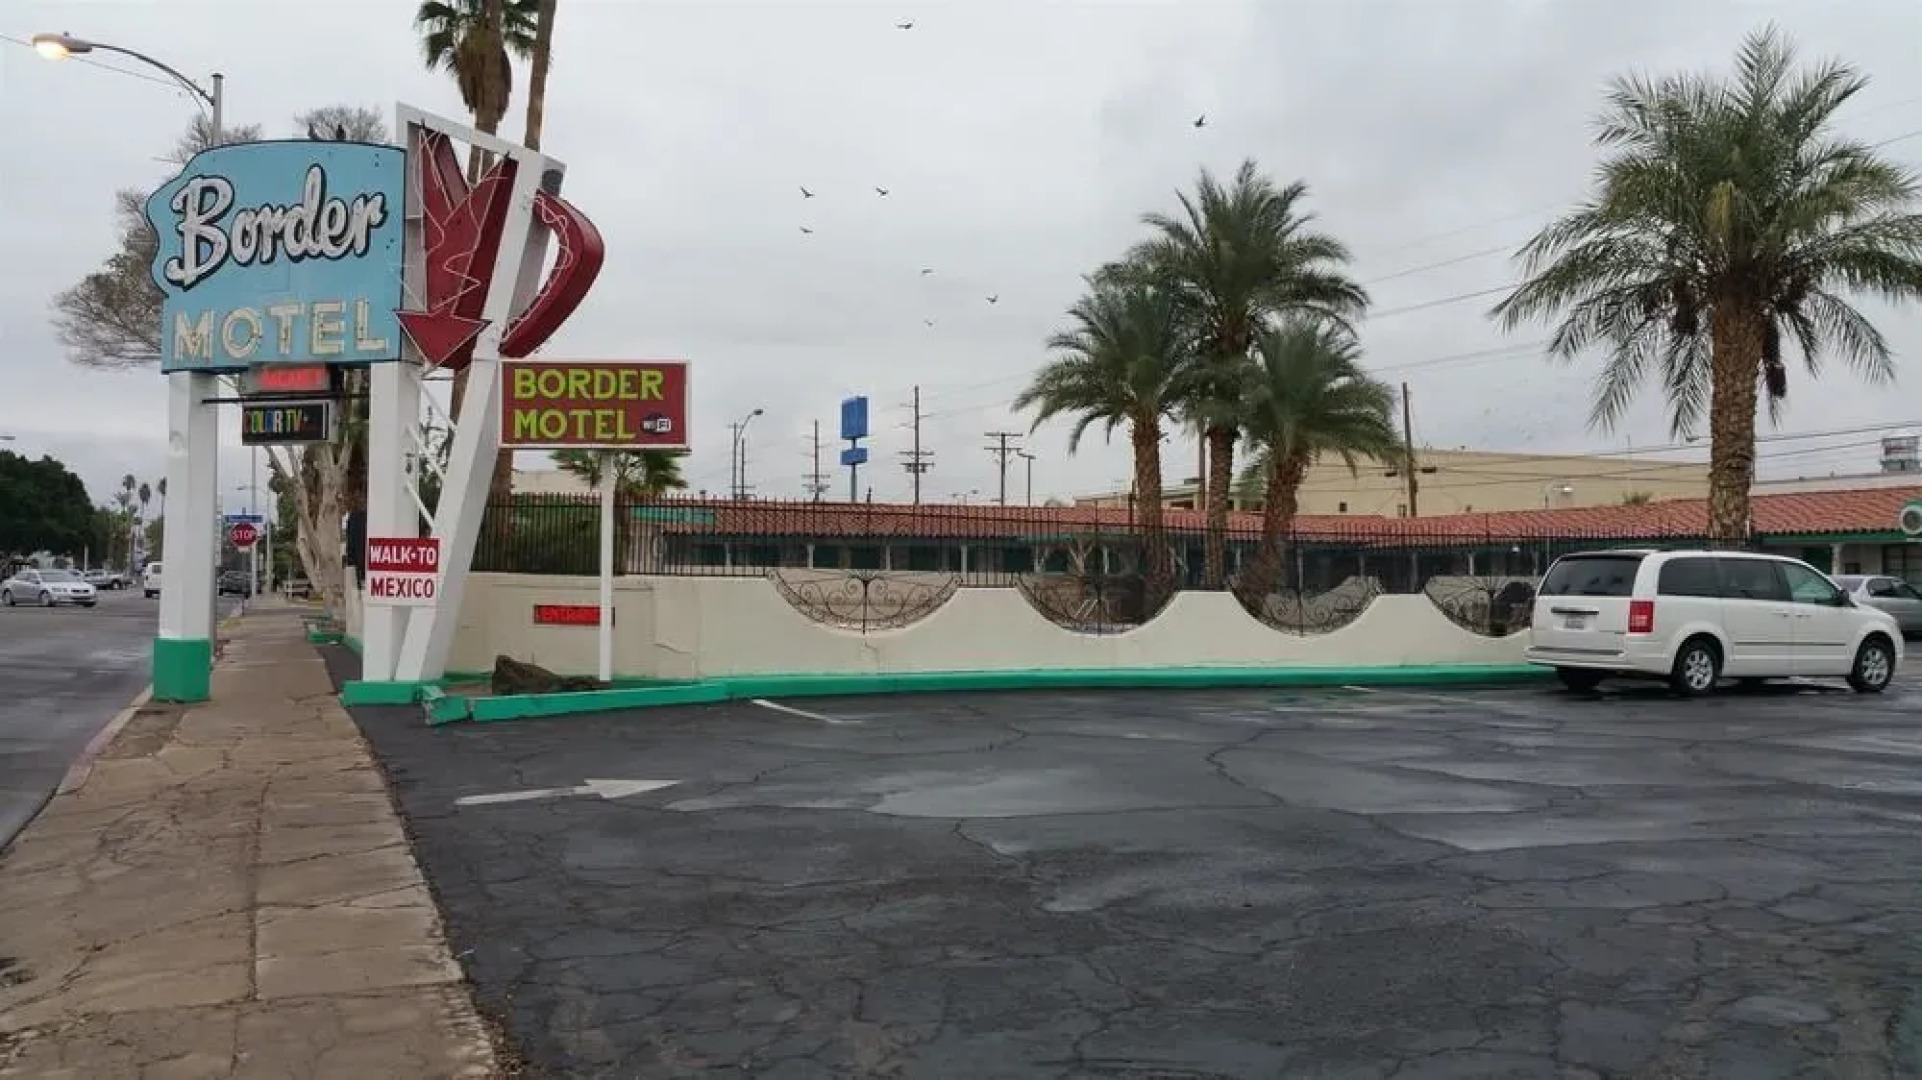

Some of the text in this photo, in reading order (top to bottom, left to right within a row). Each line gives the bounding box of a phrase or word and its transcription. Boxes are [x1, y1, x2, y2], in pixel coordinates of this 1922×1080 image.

[165, 163, 387, 291] Border
[172, 297, 388, 361] MOTEL
[514, 369, 664, 399] BORDER
[514, 409, 636, 439] MOTEL
[231, 529, 256, 541] STOP
[370, 577, 435, 598] MEXICO
